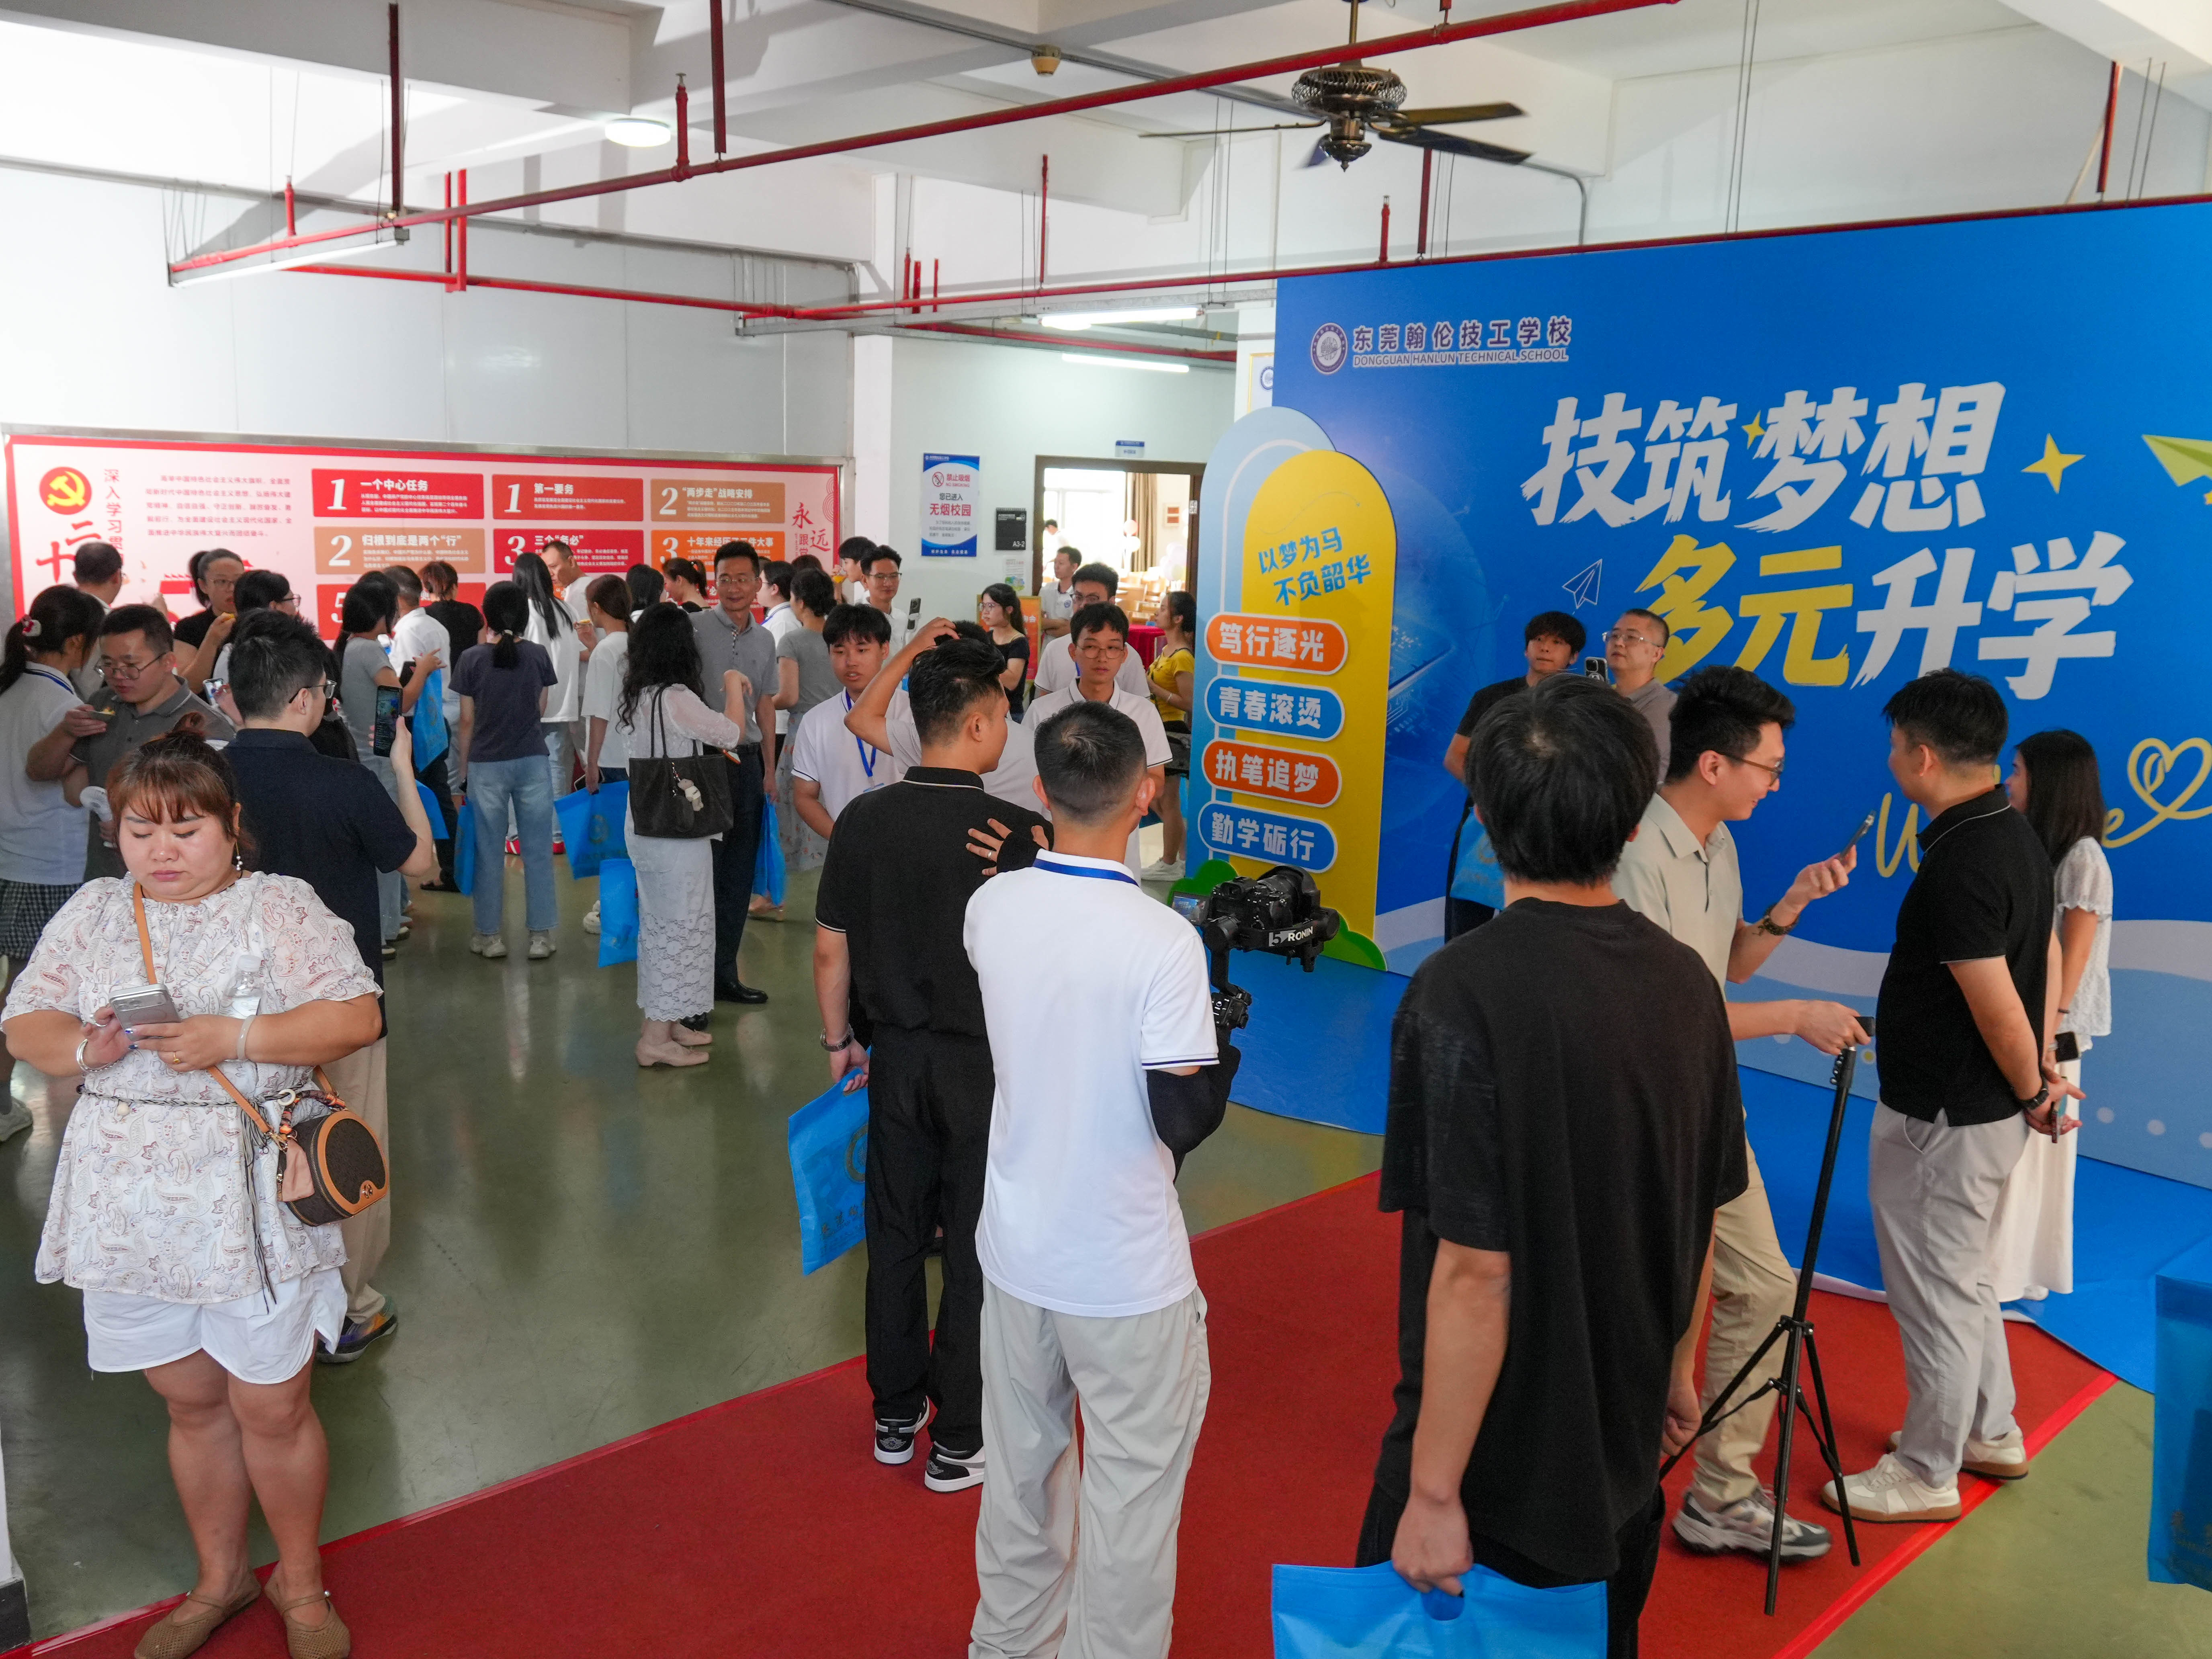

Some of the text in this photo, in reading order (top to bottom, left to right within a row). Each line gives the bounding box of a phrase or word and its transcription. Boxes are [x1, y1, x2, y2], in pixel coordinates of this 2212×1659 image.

[1353, 316, 1570, 351] 东莞翰伦技工学校
[1354, 348, 1567, 366] DONGGUAN HANLUN TECHNICAL SCHOOL
[1521, 382, 2005, 533] 技筑梦想
[360, 479, 428, 492] 一个中心任务
[534, 483, 574, 495] 第一要务
[946, 473, 970, 482] 禁止吸烟
[327, 479, 347, 510] 1
[504, 483, 522, 513] 1
[659, 487, 678, 515] 2
[682, 487, 753, 499] “两步走”战略安排
[939, 492, 963, 501] 您已进入
[104, 469, 124, 566] 深入学习贯
[930, 503, 971, 516] 无烟校园
[328, 535, 352, 566] 2
[362, 535, 462, 547] 归根到底是两个“行”
[687, 537, 774, 547] 十年来经历件大事
[1258, 526, 1344, 575] 以梦为马
[1273, 553, 1371, 606] 不负韶华
[1635, 530, 2134, 700] 多元升学
[1219, 622, 1324, 662] 笃行逐光
[1219, 686, 1321, 729] 青春滚烫
[1215, 749, 1319, 793] 执笔追梦
[1211, 812, 1314, 861] 勤学砺行
[1288, 926, 1313, 941] RONIN
